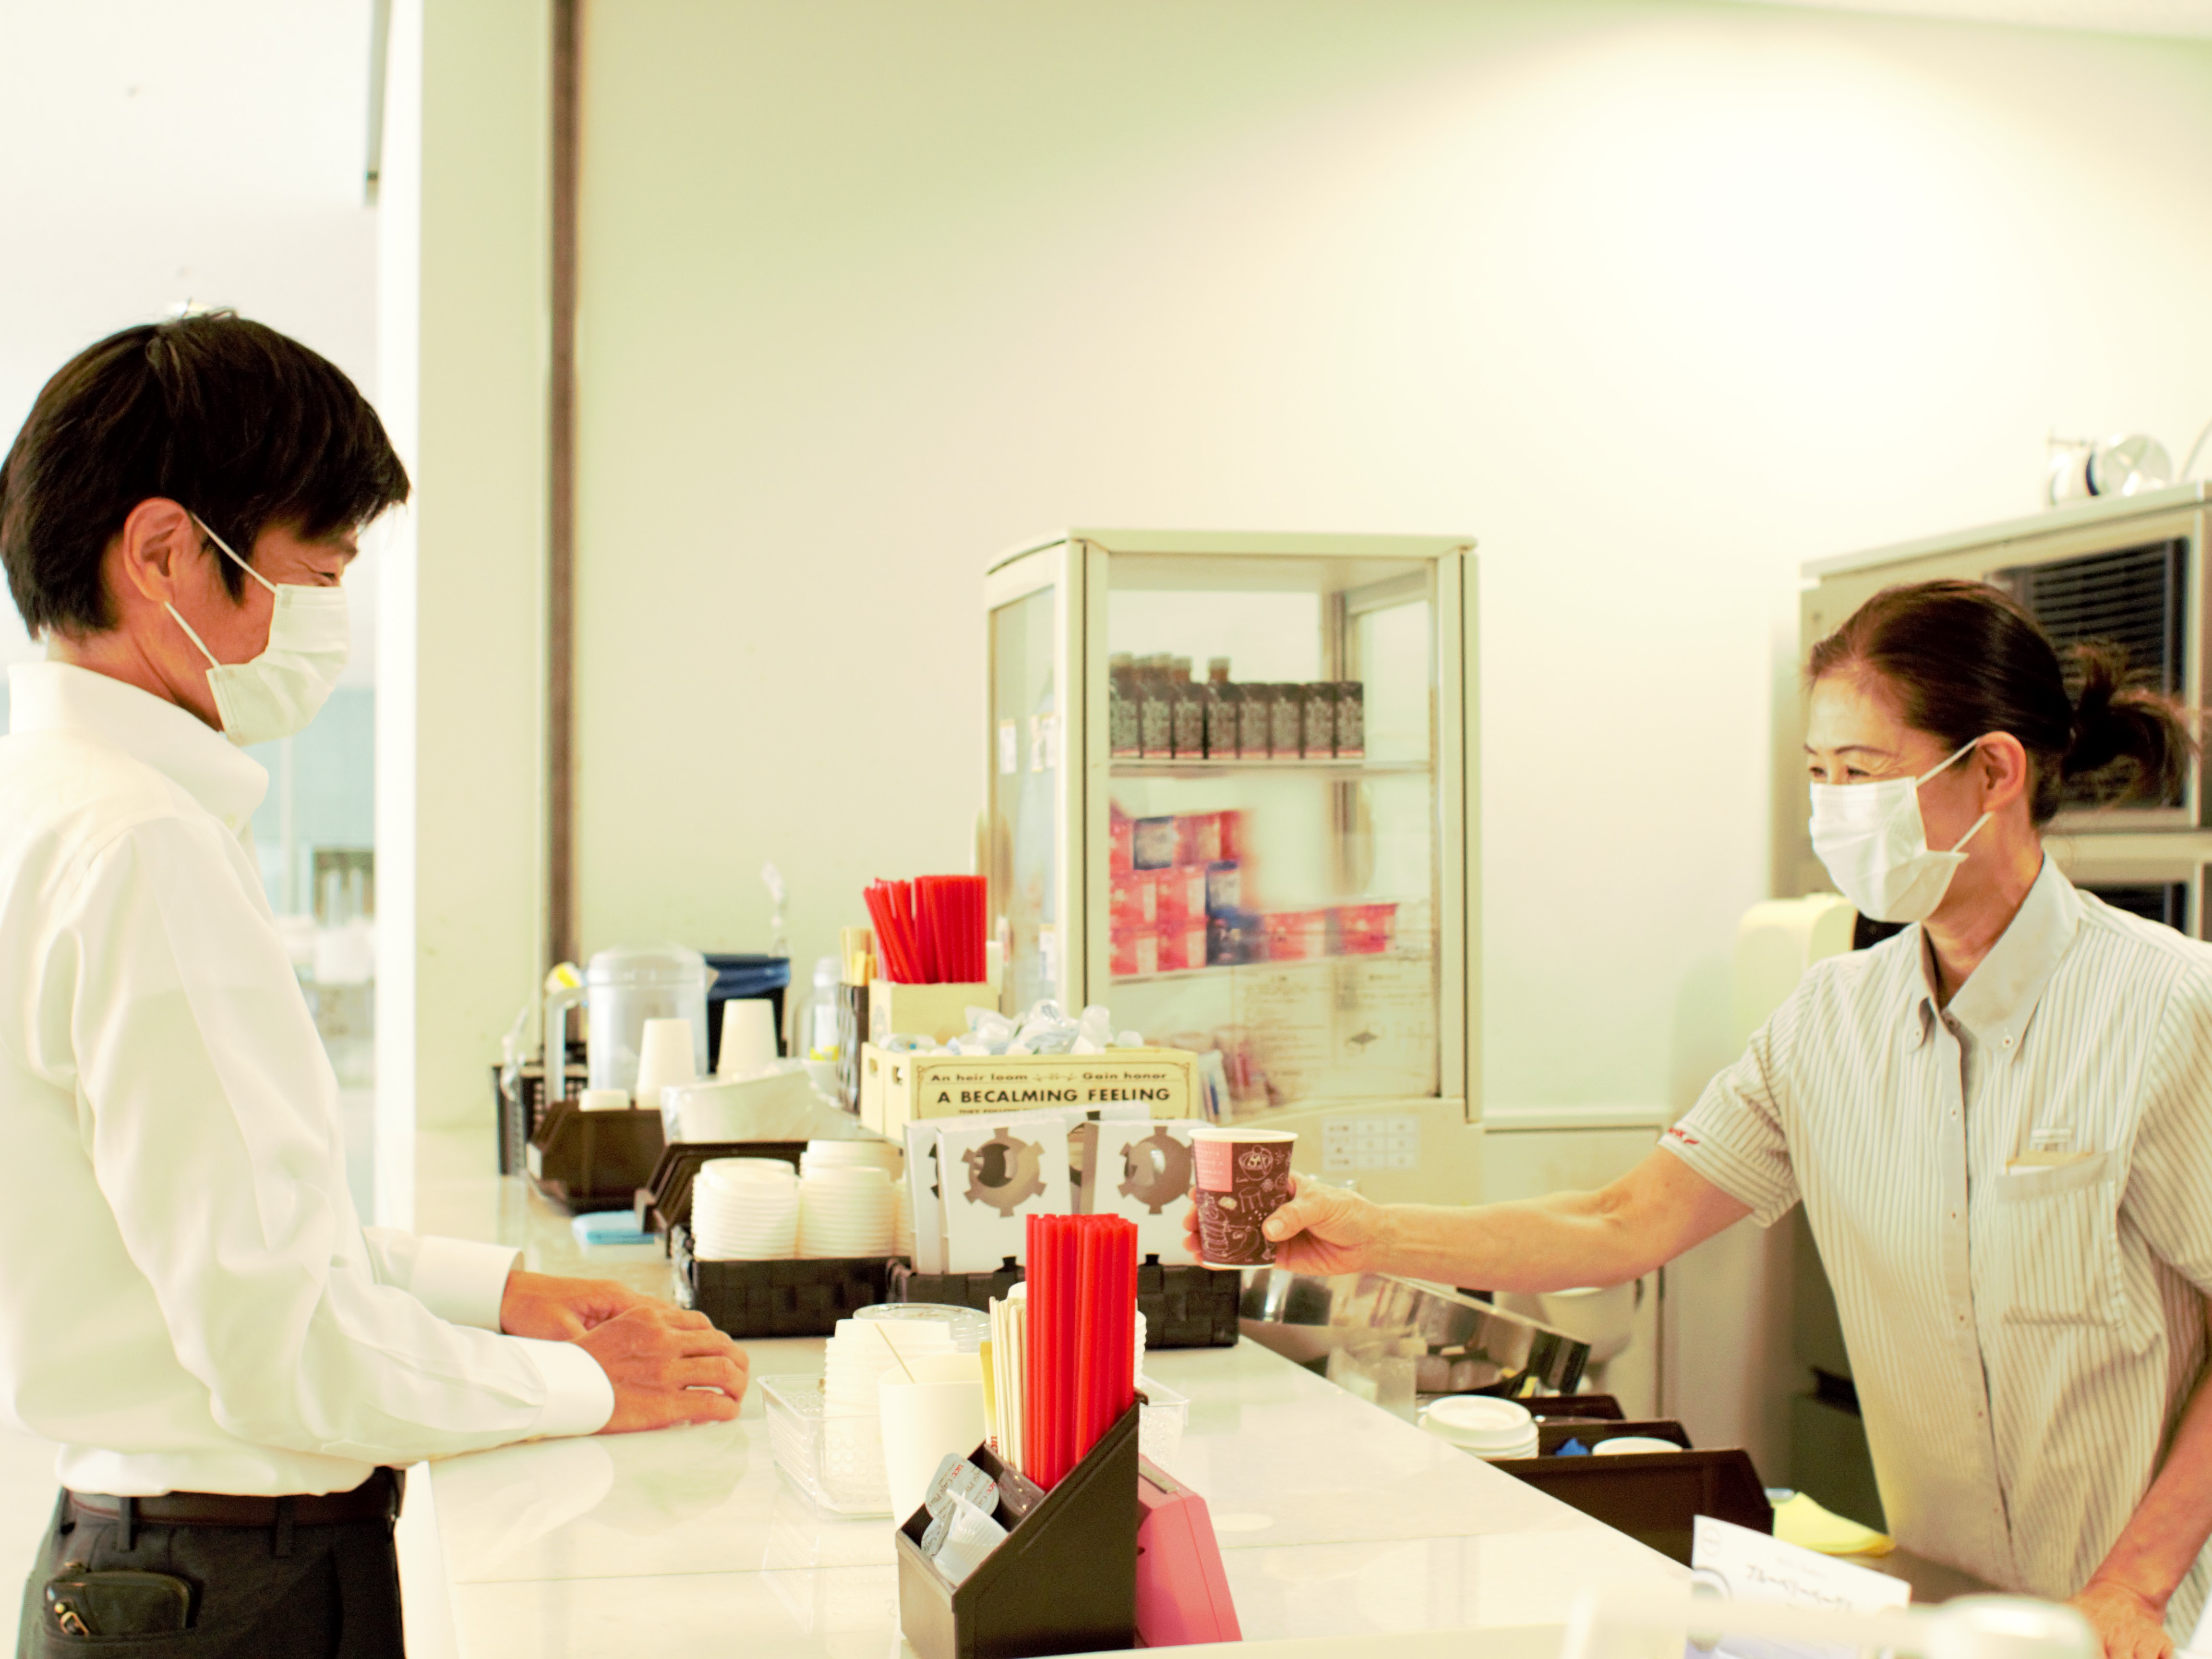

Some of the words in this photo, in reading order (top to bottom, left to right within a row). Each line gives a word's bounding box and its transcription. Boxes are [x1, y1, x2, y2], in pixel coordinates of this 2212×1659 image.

[991, 1072, 1028, 1081] loom
[1082, 1072, 1118, 1080] Gain
[1124, 1071, 1166, 1080] honor
[937, 1091, 950, 1103] A
[961, 1089, 1078, 1103] BECALMING
[1088, 1088, 1170, 1101] FEELING
